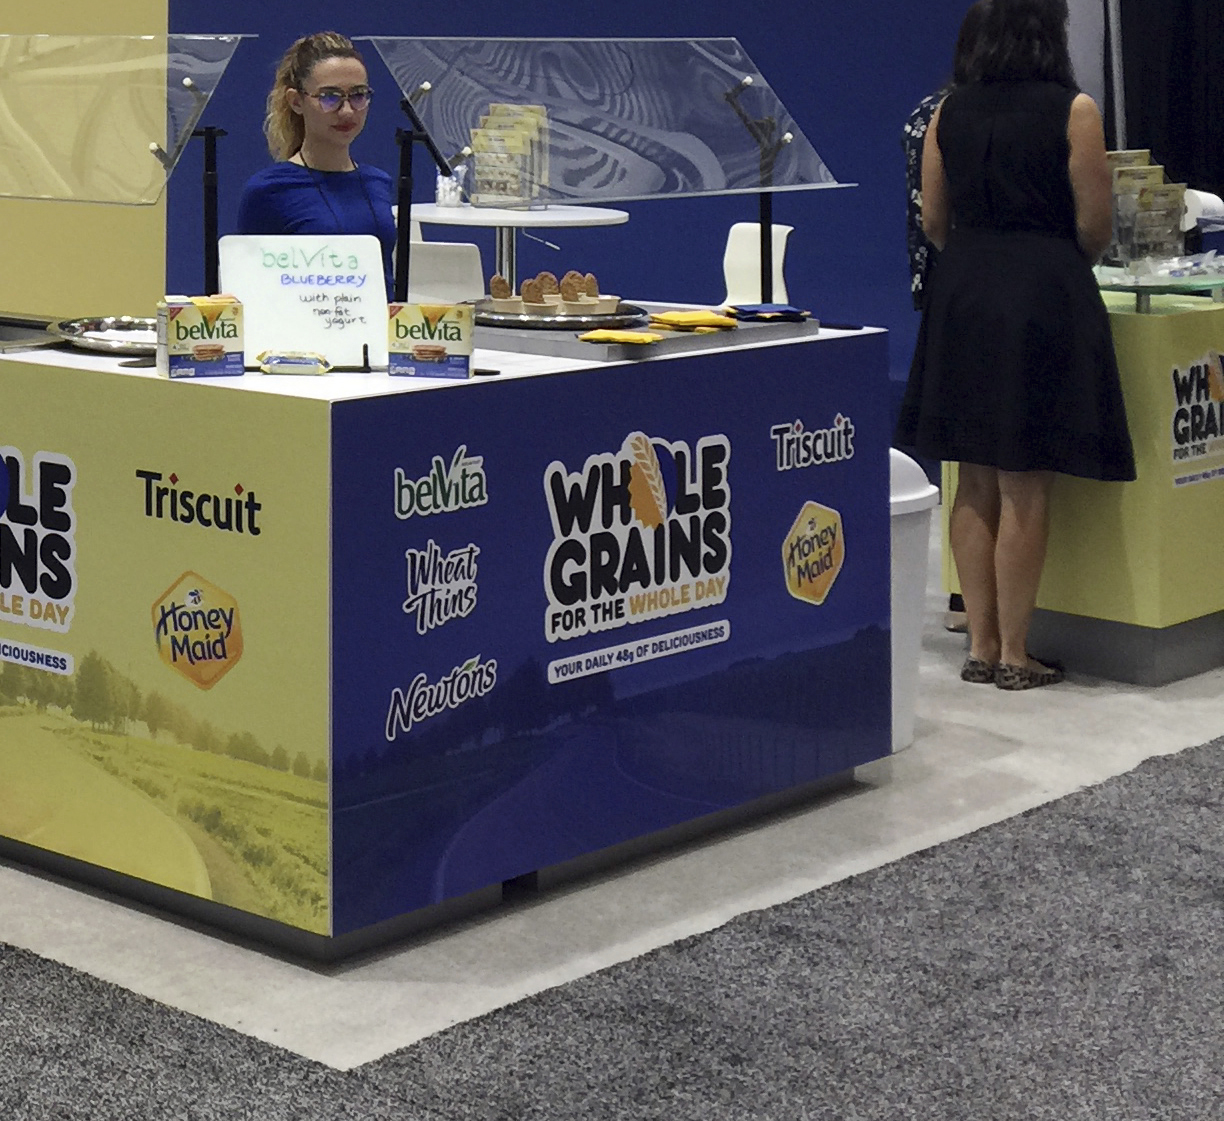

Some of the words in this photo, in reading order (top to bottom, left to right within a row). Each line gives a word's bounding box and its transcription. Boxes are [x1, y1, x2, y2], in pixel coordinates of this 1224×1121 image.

[281, 273, 367, 288] BLUEBERRY
[299, 293, 329, 303] with
[334, 293, 362, 305] plain
[773, 416, 853, 468] Triscuit
[136, 469, 262, 536] Triscuit
[408, 543, 478, 594] Wheat
[550, 511, 726, 606] GRAINS
[789, 523, 837, 568] Honey
[796, 548, 833, 588] Maid
[30, 598, 69, 626] DAY
[156, 601, 234, 644] Honey
[406, 585, 475, 631] Thins
[552, 607, 586, 634] FOR
[591, 598, 625, 624] THE
[629, 584, 691, 616] WHOLE
[695, 576, 726, 601] DAY
[171, 632, 228, 665] Maid
[554, 660, 582, 678] YOUR
[586, 653, 614, 670] DAILY
[617, 650, 634, 663] 48g
[636, 645, 650, 658] OF
[652, 627, 725, 653] DELICIOUSNESS
[387, 661, 496, 739] Newtons
